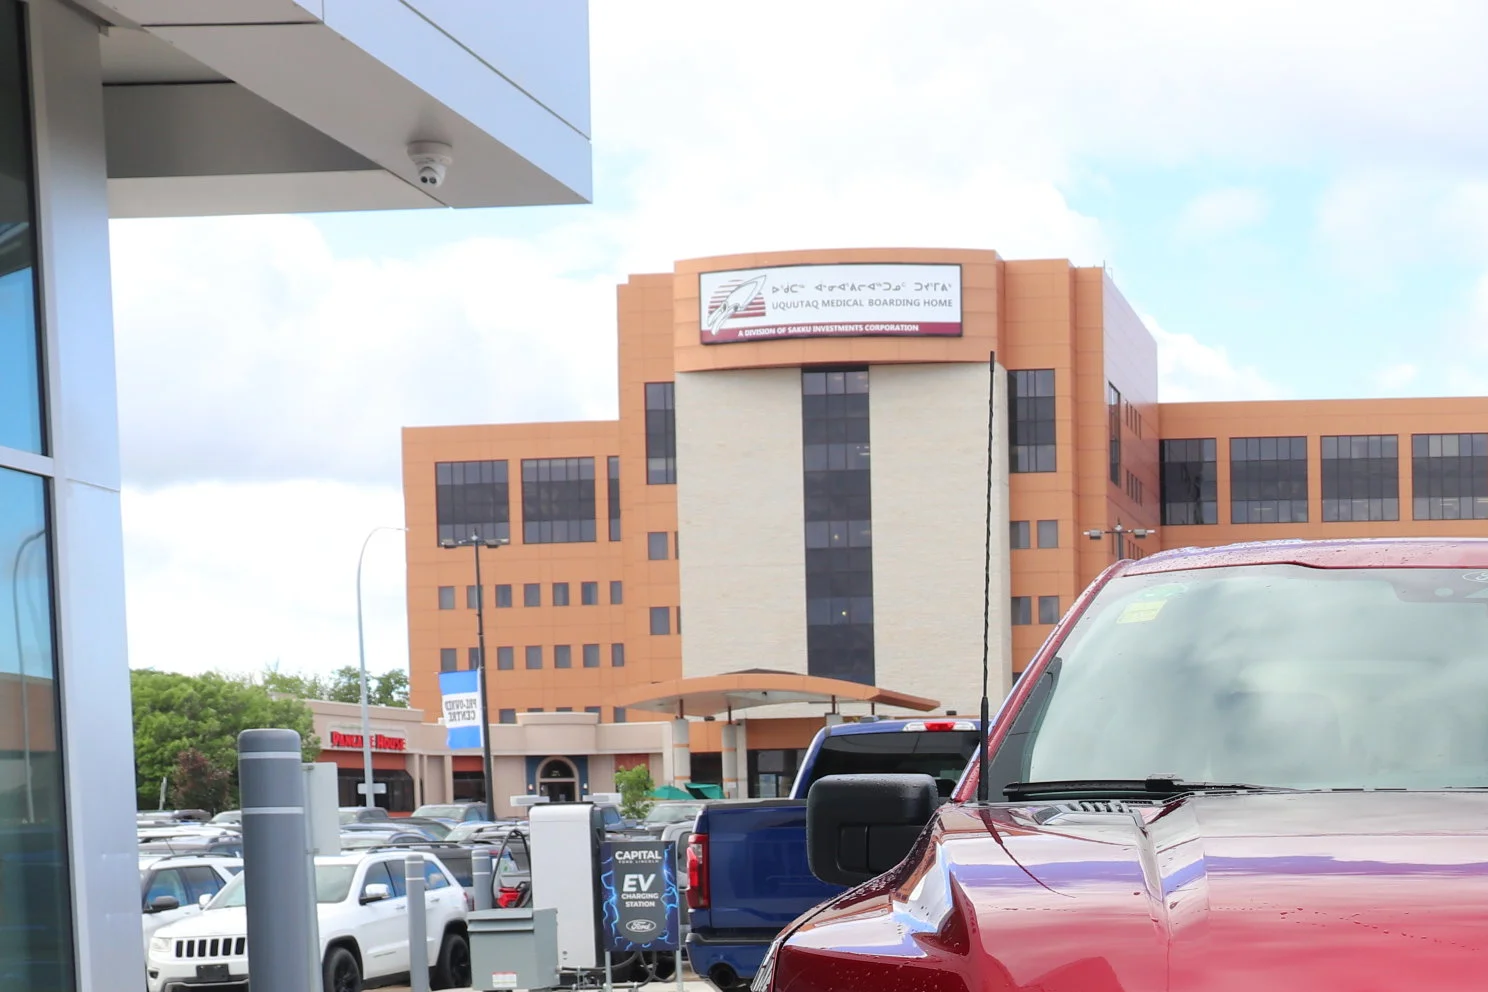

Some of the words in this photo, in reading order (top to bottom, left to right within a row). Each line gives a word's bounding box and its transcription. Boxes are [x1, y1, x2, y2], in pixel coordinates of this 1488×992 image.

[772, 300, 820, 311] UQUUTAQ
[821, 299, 864, 307] MEDICAL
[868, 298, 920, 307] BOARDING
[923, 298, 953, 307] HOME
[745, 328, 776, 336] DIVISION
[812, 325, 863, 333] INVESTMENTS
[865, 324, 919, 332] CORPORATION
[331, 731, 375, 748] PANCAE
[376, 734, 406, 750] HOUSE
[615, 850, 662, 860] CAPITAL
[622, 873, 656, 892] EV
